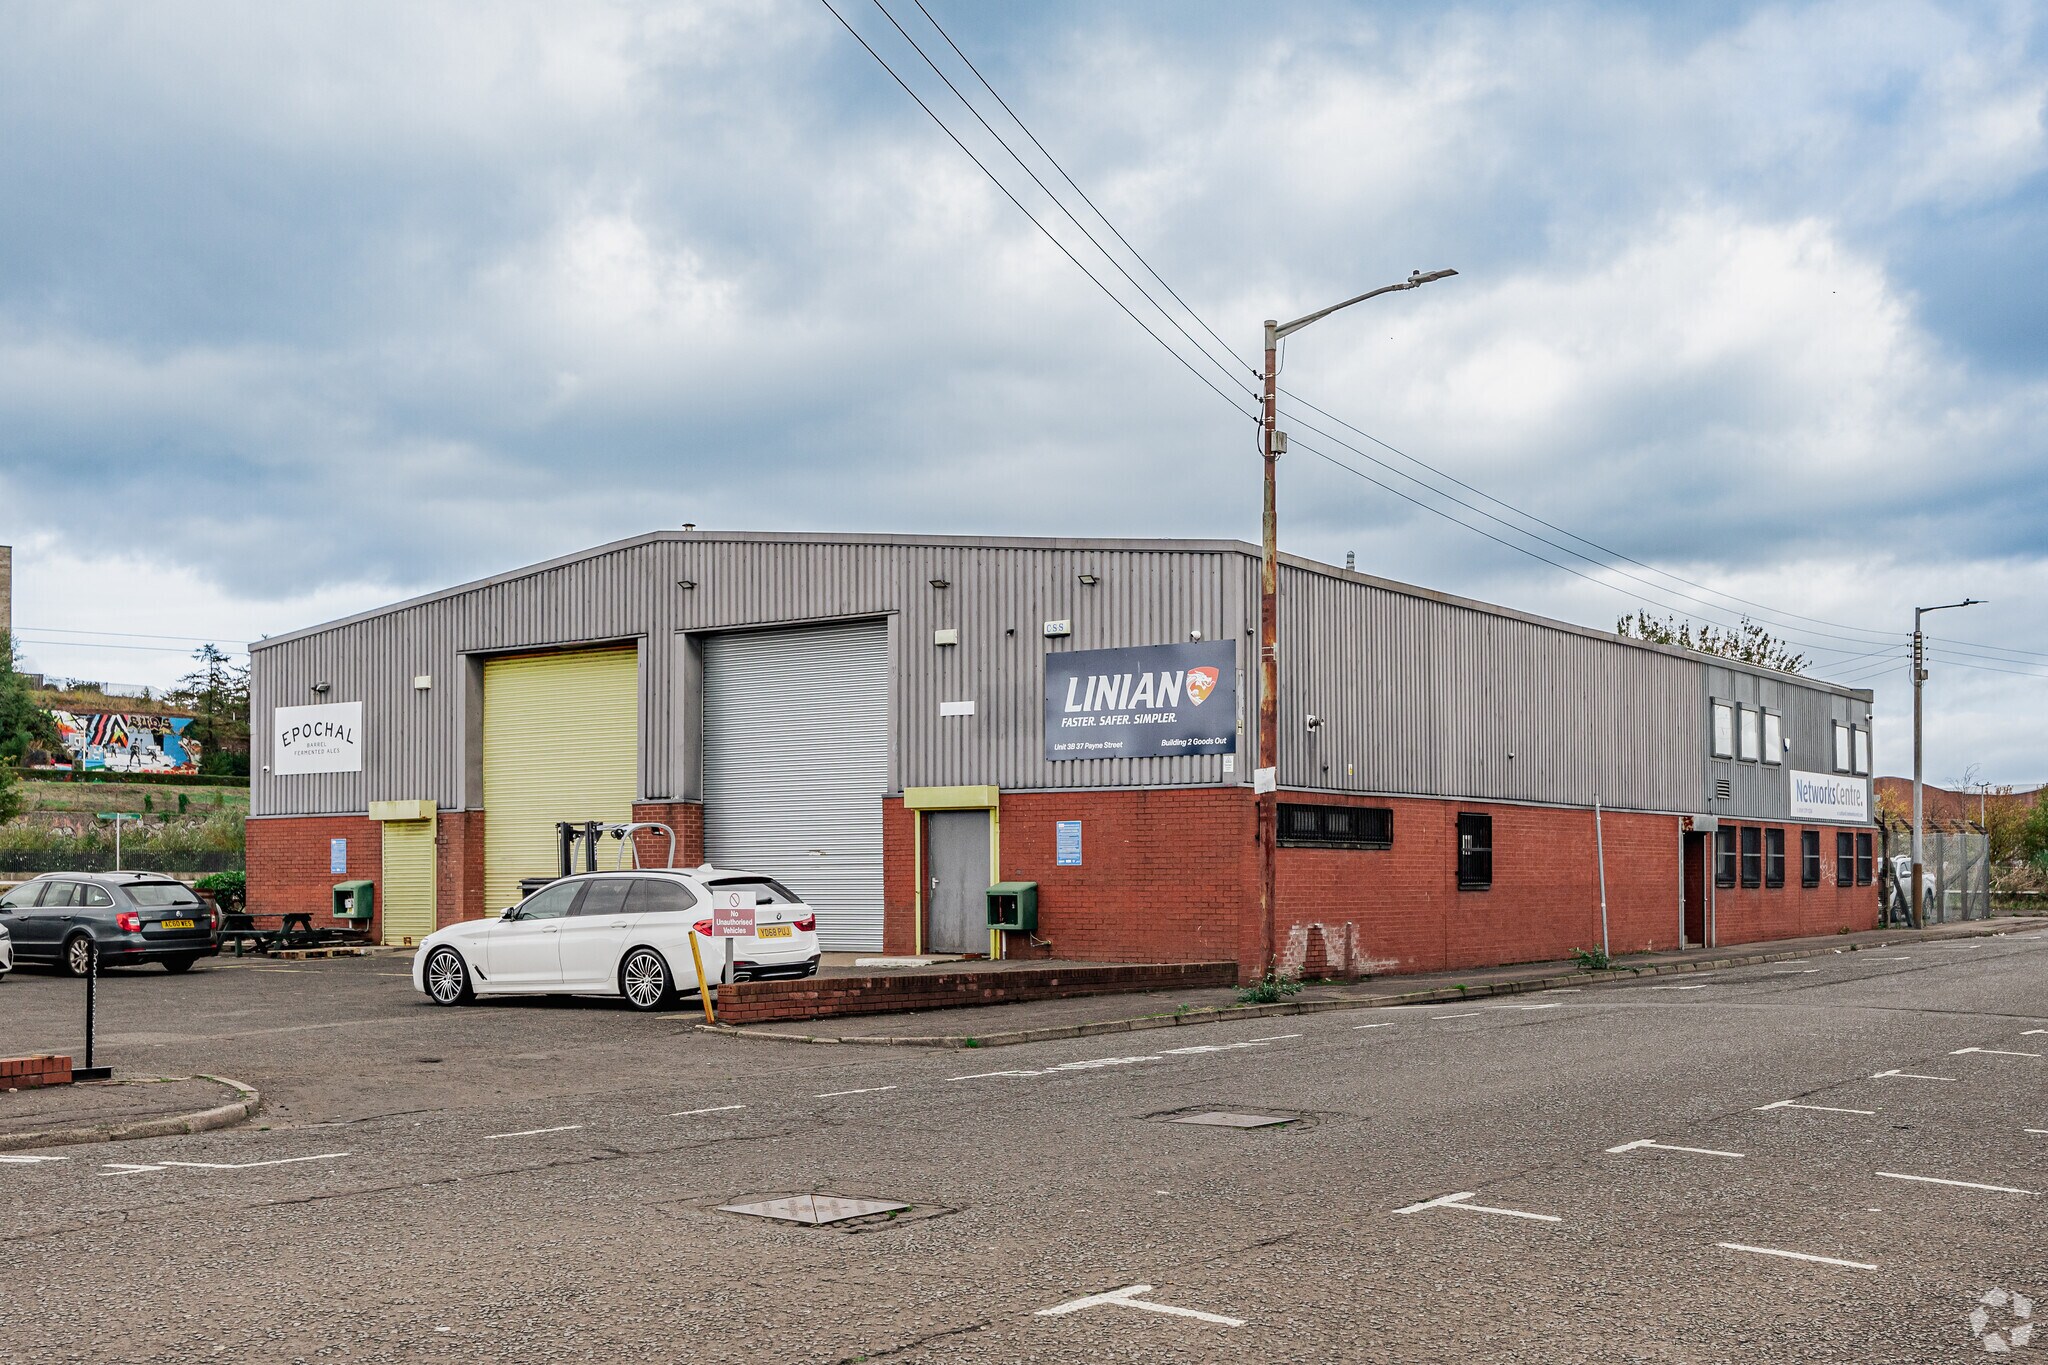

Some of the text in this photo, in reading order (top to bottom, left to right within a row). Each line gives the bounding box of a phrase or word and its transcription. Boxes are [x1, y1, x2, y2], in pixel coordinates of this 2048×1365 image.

[1064, 670, 1184, 713] LINIAN
[1061, 712, 1177, 728] FASTER. SAFER. SIMPLER.
[281, 721, 354, 748] EPOCHAL
[1076, 742, 1085, 750] 37
[1084, 742, 1104, 751] Payne
[1161, 739, 1187, 748] Building
[1192, 738, 1214, 746] Goods
